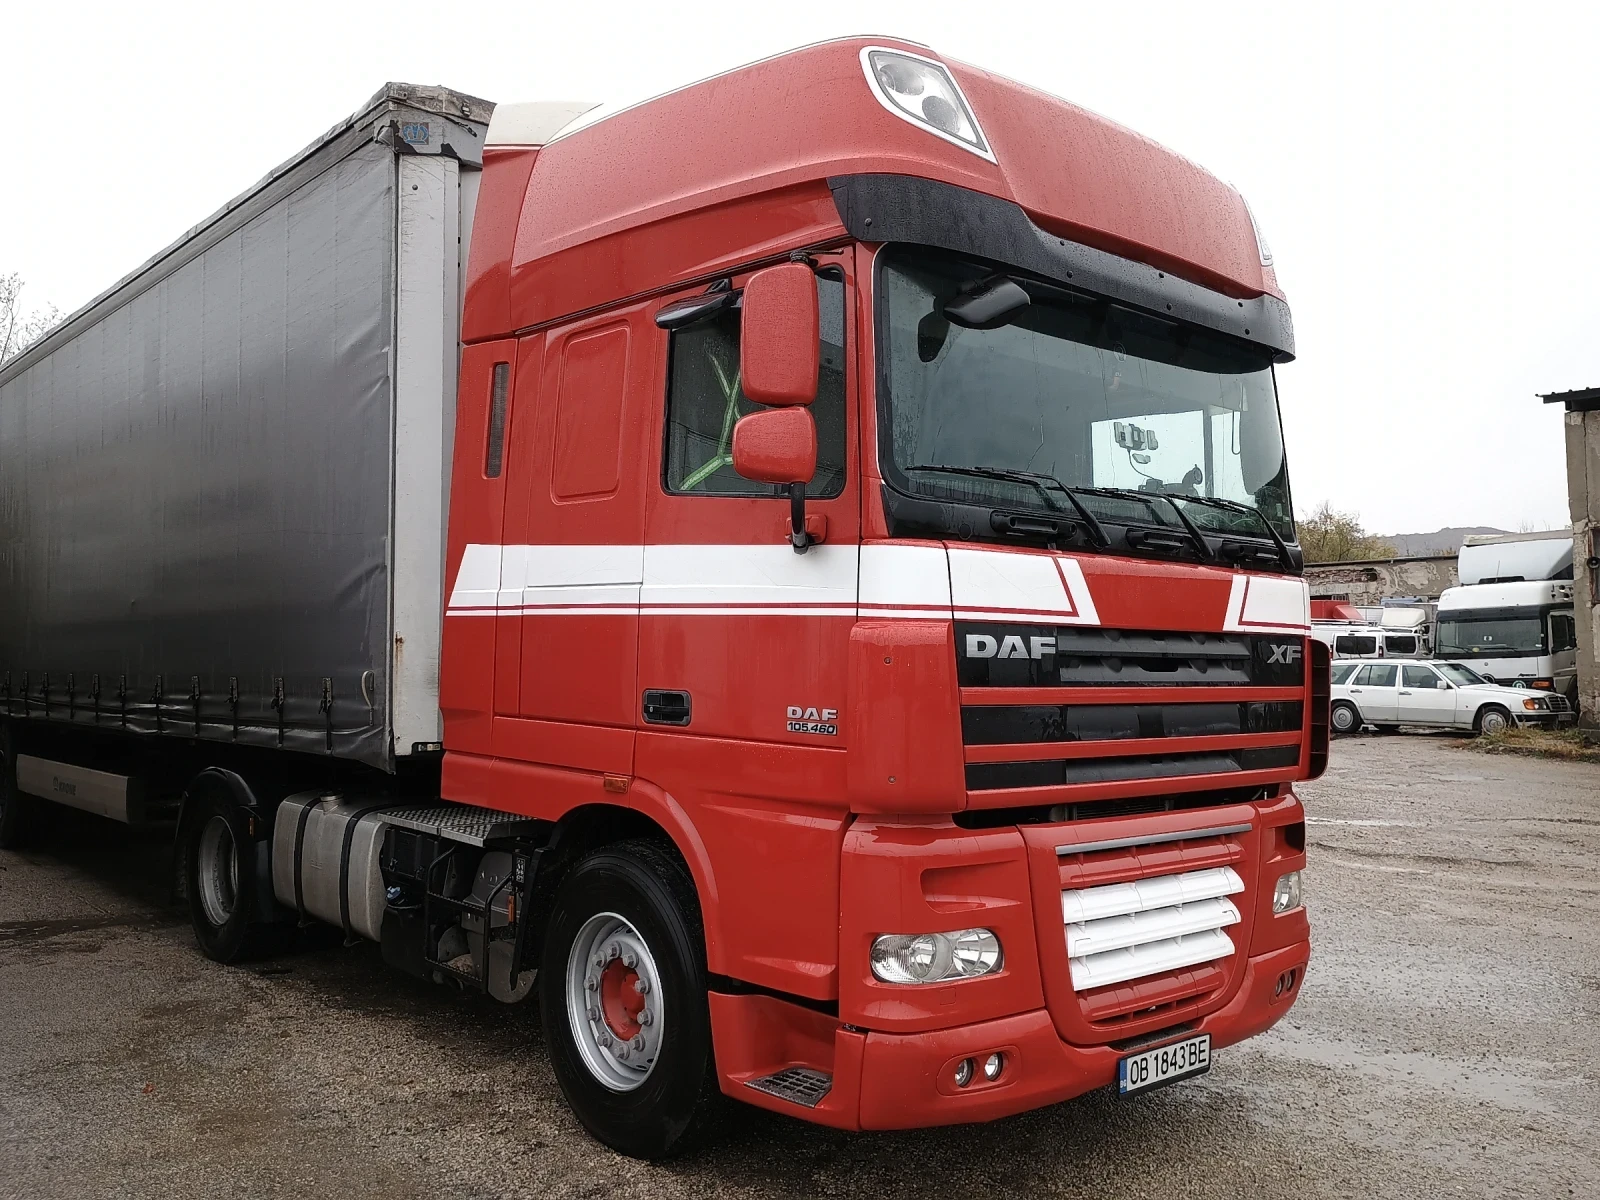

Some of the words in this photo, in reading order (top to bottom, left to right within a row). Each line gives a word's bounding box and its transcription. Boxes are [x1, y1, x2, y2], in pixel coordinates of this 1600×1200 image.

[965, 634, 1057, 660] DAF
[1266, 644, 1302, 665] XF
[787, 706, 838, 721] DAF
[788, 722, 836, 734] 105.460
[1130, 1057, 1149, 1085] OB
[1153, 1045, 1186, 1078] 1843
[1188, 1039, 1207, 1067] BE
